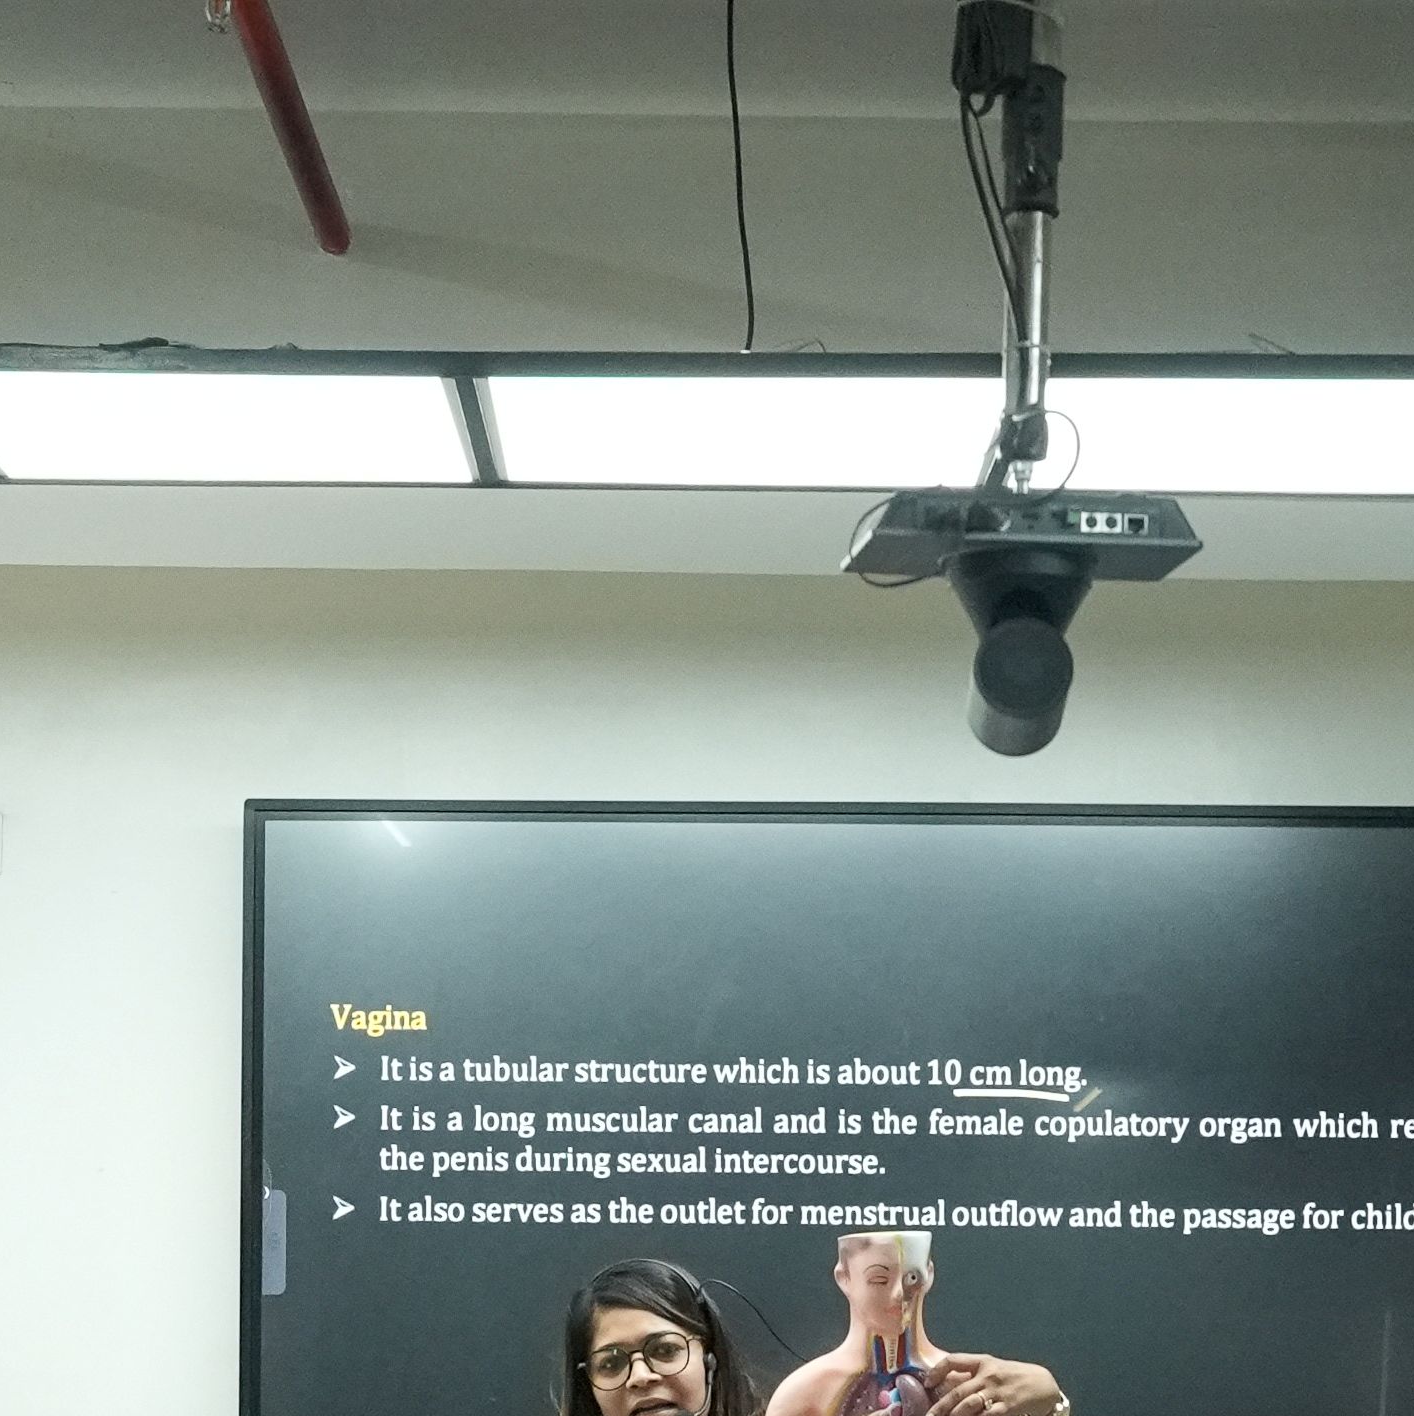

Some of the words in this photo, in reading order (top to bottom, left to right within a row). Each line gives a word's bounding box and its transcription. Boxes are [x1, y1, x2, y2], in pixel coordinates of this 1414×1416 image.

[330, 1004, 427, 1037] Vagina
[381, 1056, 403, 1081] It
[410, 1056, 432, 1081] is
[439, 1062, 455, 1081] a
[463, 1055, 569, 1082] tubular
[575, 1060, 707, 1083] structure
[713, 1057, 799, 1084] which
[807, 1059, 830, 1084] is
[838, 1058, 920, 1085] about
[928, 1059, 961, 1085] 10
[970, 1065, 1012, 1085] cm
[1019, 1060, 1088, 1091] long.
[381, 1105, 402, 1130] It
[413, 1106, 435, 1131] is
[447, 1112, 463, 1131] a
[474, 1105, 535, 1138] long
[547, 1106, 678, 1132] muscular
[689, 1107, 762, 1133] canal
[774, 1107, 826, 1134] and
[838, 1109, 861, 1134] is
[872, 1108, 917, 1135] the
[929, 1108, 1023, 1135] female
[1035, 1107, 1189, 1143] copulatory
[1199, 1117, 1282, 1144] organ
[1293, 1111, 1378, 1138] which
[380, 1144, 424, 1171] the
[432, 1146, 508, 1177] penis
[516, 1145, 611, 1178] during
[617, 1146, 706, 1173] sexual
[715, 1148, 885, 1174] intercourse.
[380, 1196, 402, 1221] It
[408, 1195, 465, 1222] also
[472, 1203, 563, 1223] serves
[571, 1204, 601, 1223] as
[608, 1197, 654, 1224] the
[661, 1197, 746, 1224] outlet
[752, 1198, 793, 1224] for
[801, 1199, 945, 1226] menstrual
[952, 1200, 1063, 1227] outflow
[1069, 1201, 1122, 1227] and
[1129, 1201, 1175, 1228] the
[1183, 1208, 1295, 1234] passage
[1303, 1202, 1344, 1229] for
